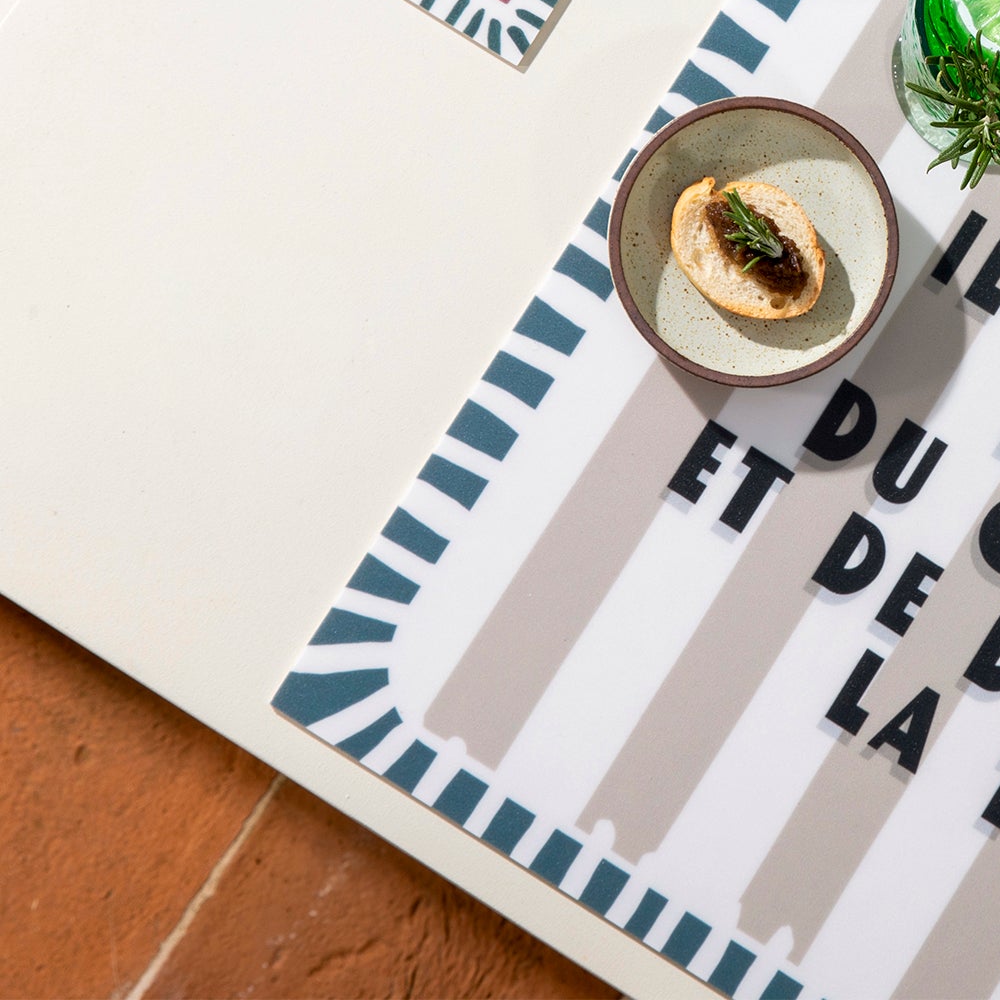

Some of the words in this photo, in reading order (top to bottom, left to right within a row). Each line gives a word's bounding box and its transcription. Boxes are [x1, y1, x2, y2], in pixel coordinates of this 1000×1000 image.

[803, 378, 950, 505] DU
[666, 420, 796, 535] ET
[811, 511, 945, 638] DE
[824, 650, 941, 775] LA
